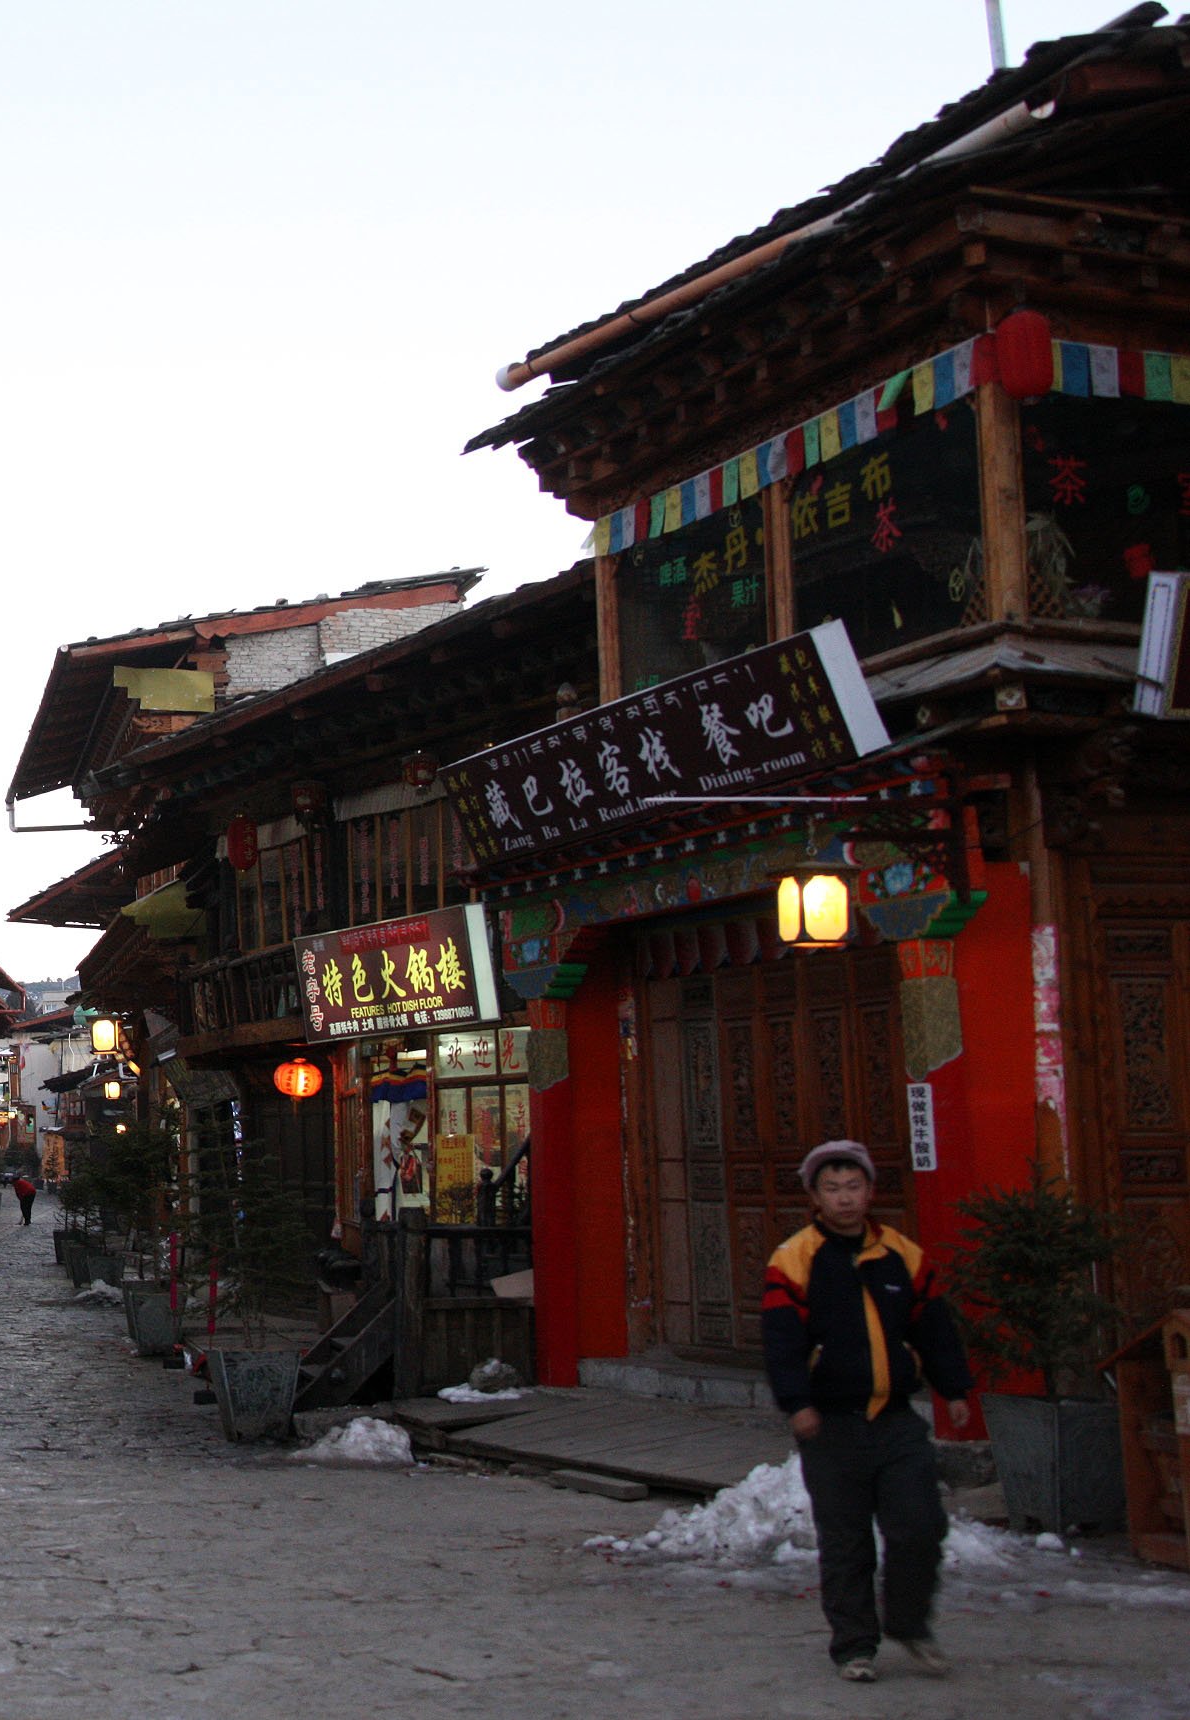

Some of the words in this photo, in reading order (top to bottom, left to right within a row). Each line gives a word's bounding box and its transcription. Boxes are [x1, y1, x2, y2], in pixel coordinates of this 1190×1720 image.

[1047, 453, 1091, 507] 茶
[871, 496, 904, 554] 茶
[731, 575, 762, 608] 果汁
[484, 726, 683, 831] 藏巴拉客栈
[501, 833, 535, 851] Zang
[541, 824, 560, 841] Ba
[568, 816, 589, 832] La
[698, 750, 807, 792] Dining-room
[301, 949, 325, 1032] 老字号
[321, 936, 468, 1008] 特色火锅楼
[350, 1003, 385, 1019] FEATURES
[386, 1001, 401, 1014] HOT
[401, 998, 419, 1013] DISH
[418, 996, 444, 1011] FLOOR
